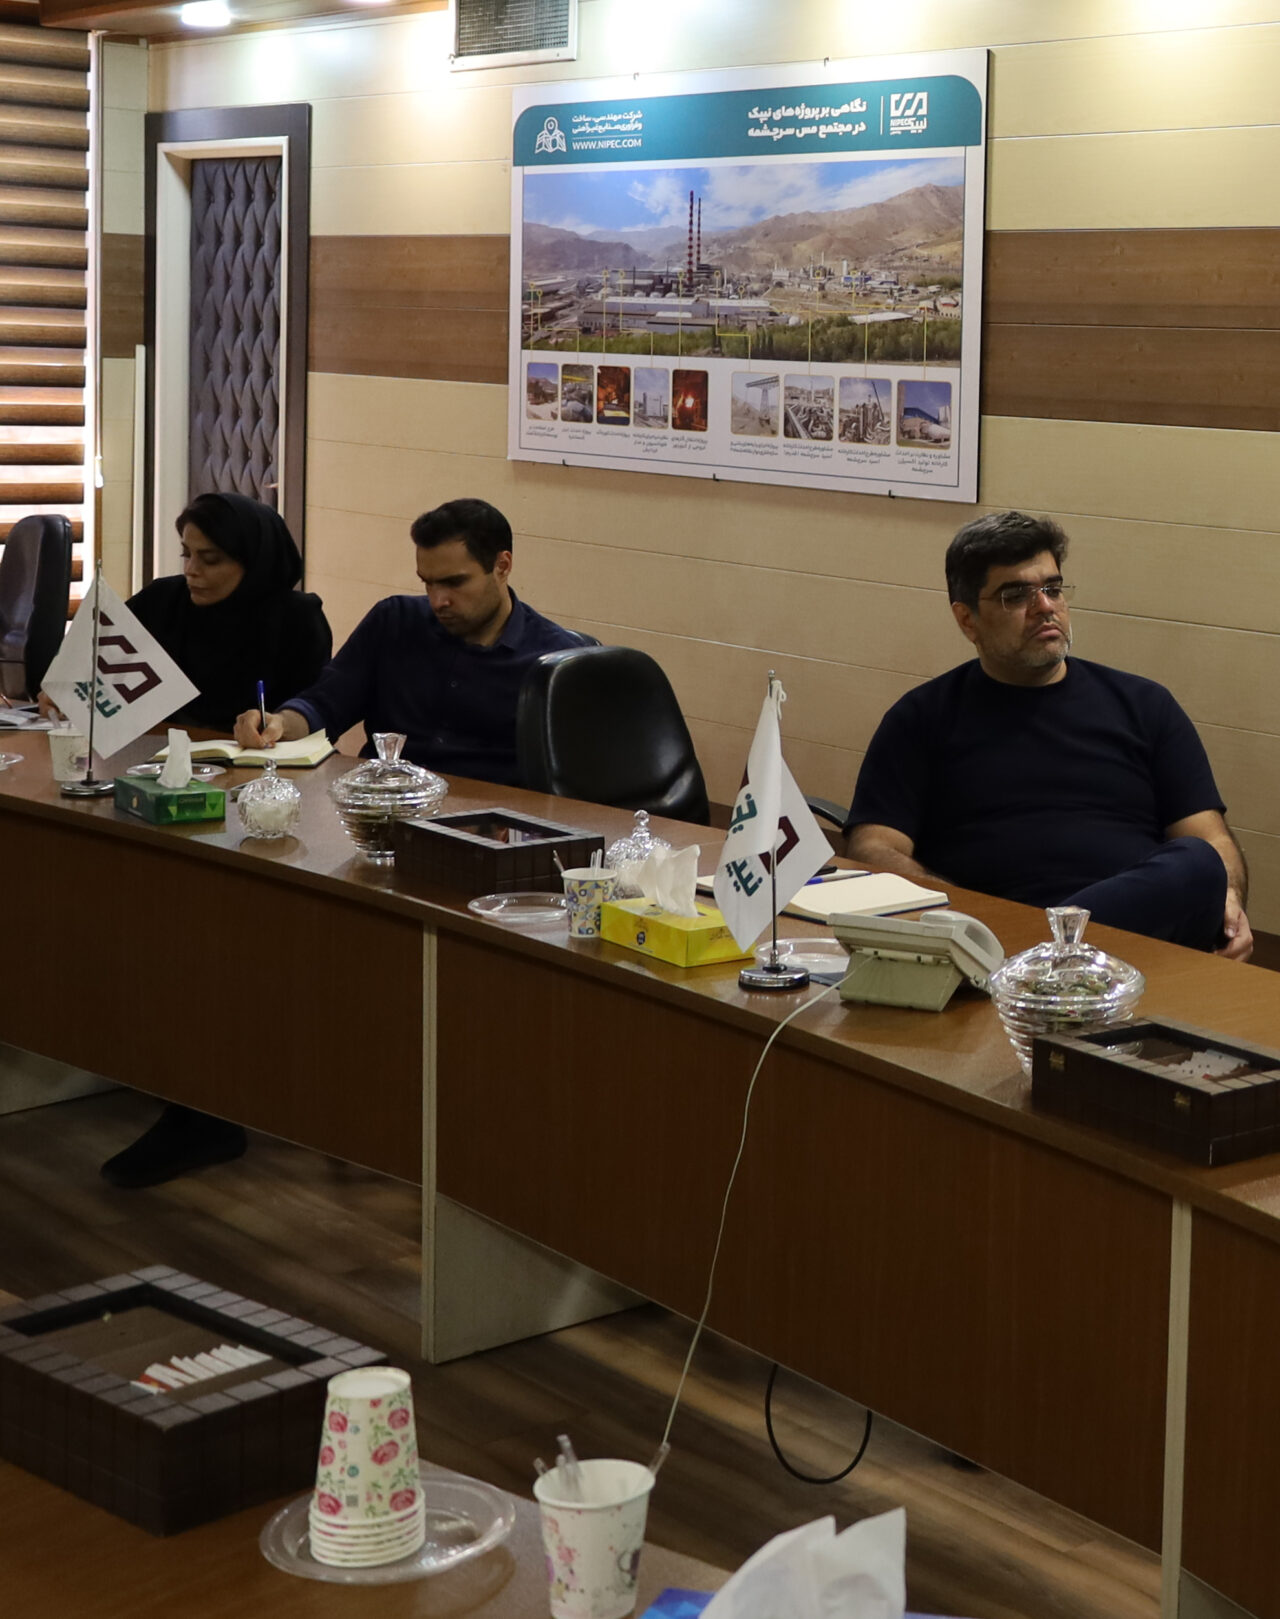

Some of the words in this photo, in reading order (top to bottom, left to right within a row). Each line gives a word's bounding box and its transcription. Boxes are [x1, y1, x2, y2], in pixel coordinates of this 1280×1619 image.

[819, 106, 830, 118] بر
[831, 97, 867, 117] نگاهی
[622, 110, 643, 122] شرکت
[748, 123, 795, 141] سرچشمه
[796, 125, 818, 138] مس
[818, 122, 853, 138] مجتمع
[852, 122, 867, 135] در
[572, 138, 642, 150] WWW.NIPEC.COM
